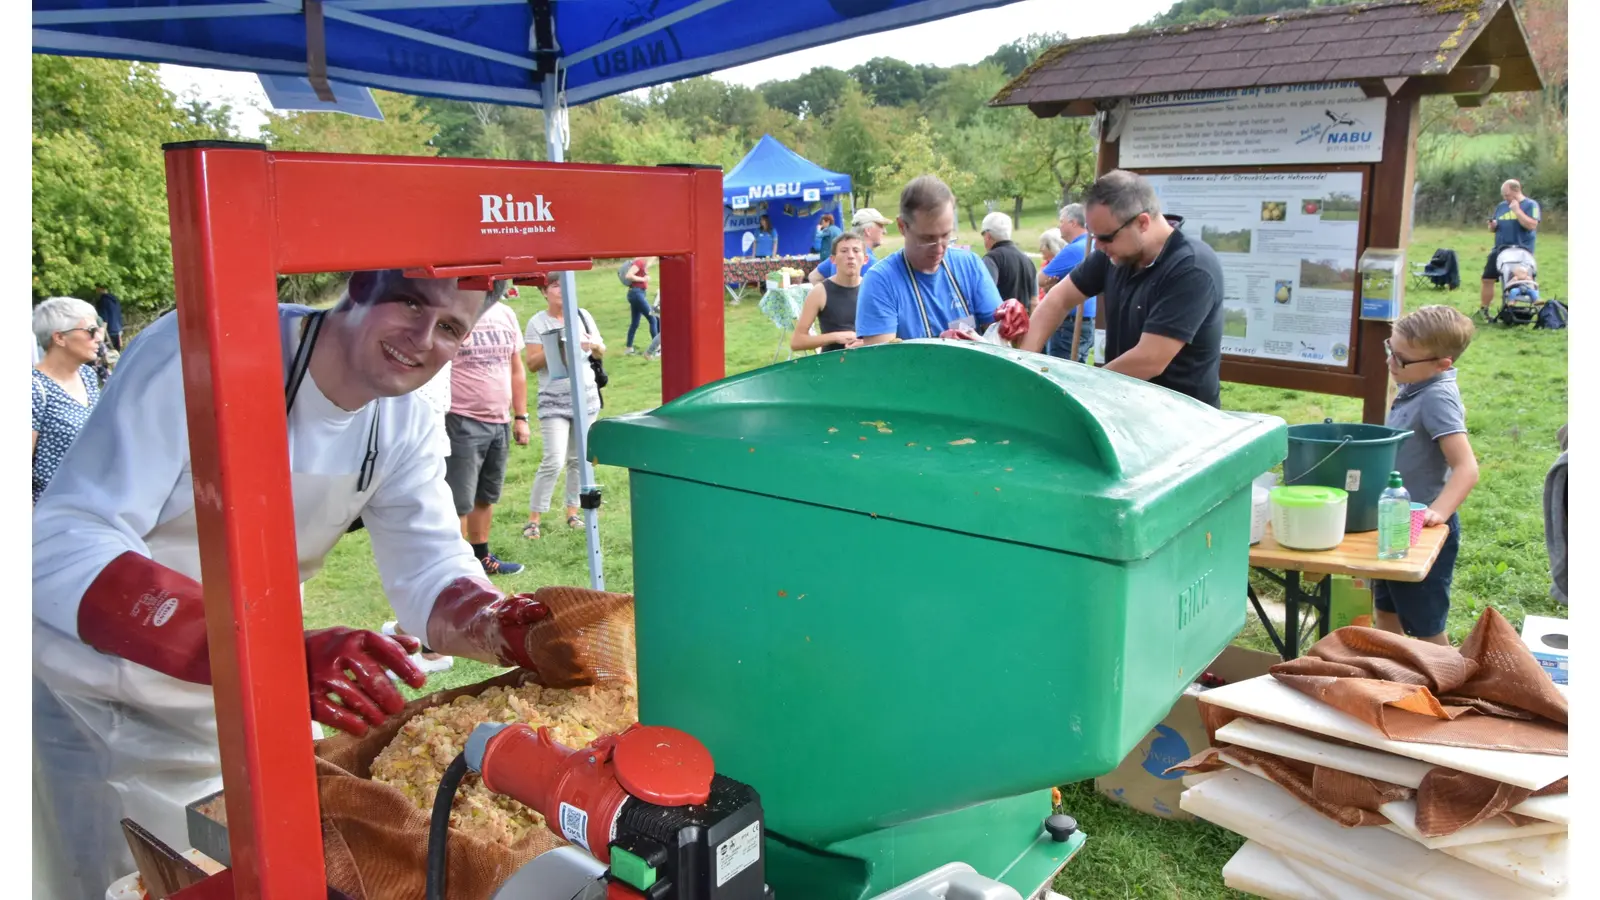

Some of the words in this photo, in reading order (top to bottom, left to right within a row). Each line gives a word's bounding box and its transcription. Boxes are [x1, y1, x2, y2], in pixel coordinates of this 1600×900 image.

[1173, 90, 1238, 103] Willkommen
[1327, 132, 1373, 144] NABU
[748, 182, 801, 200] NABU
[479, 193, 555, 223] Rink
[480, 225, 556, 235] www.rink-gmbh.de
